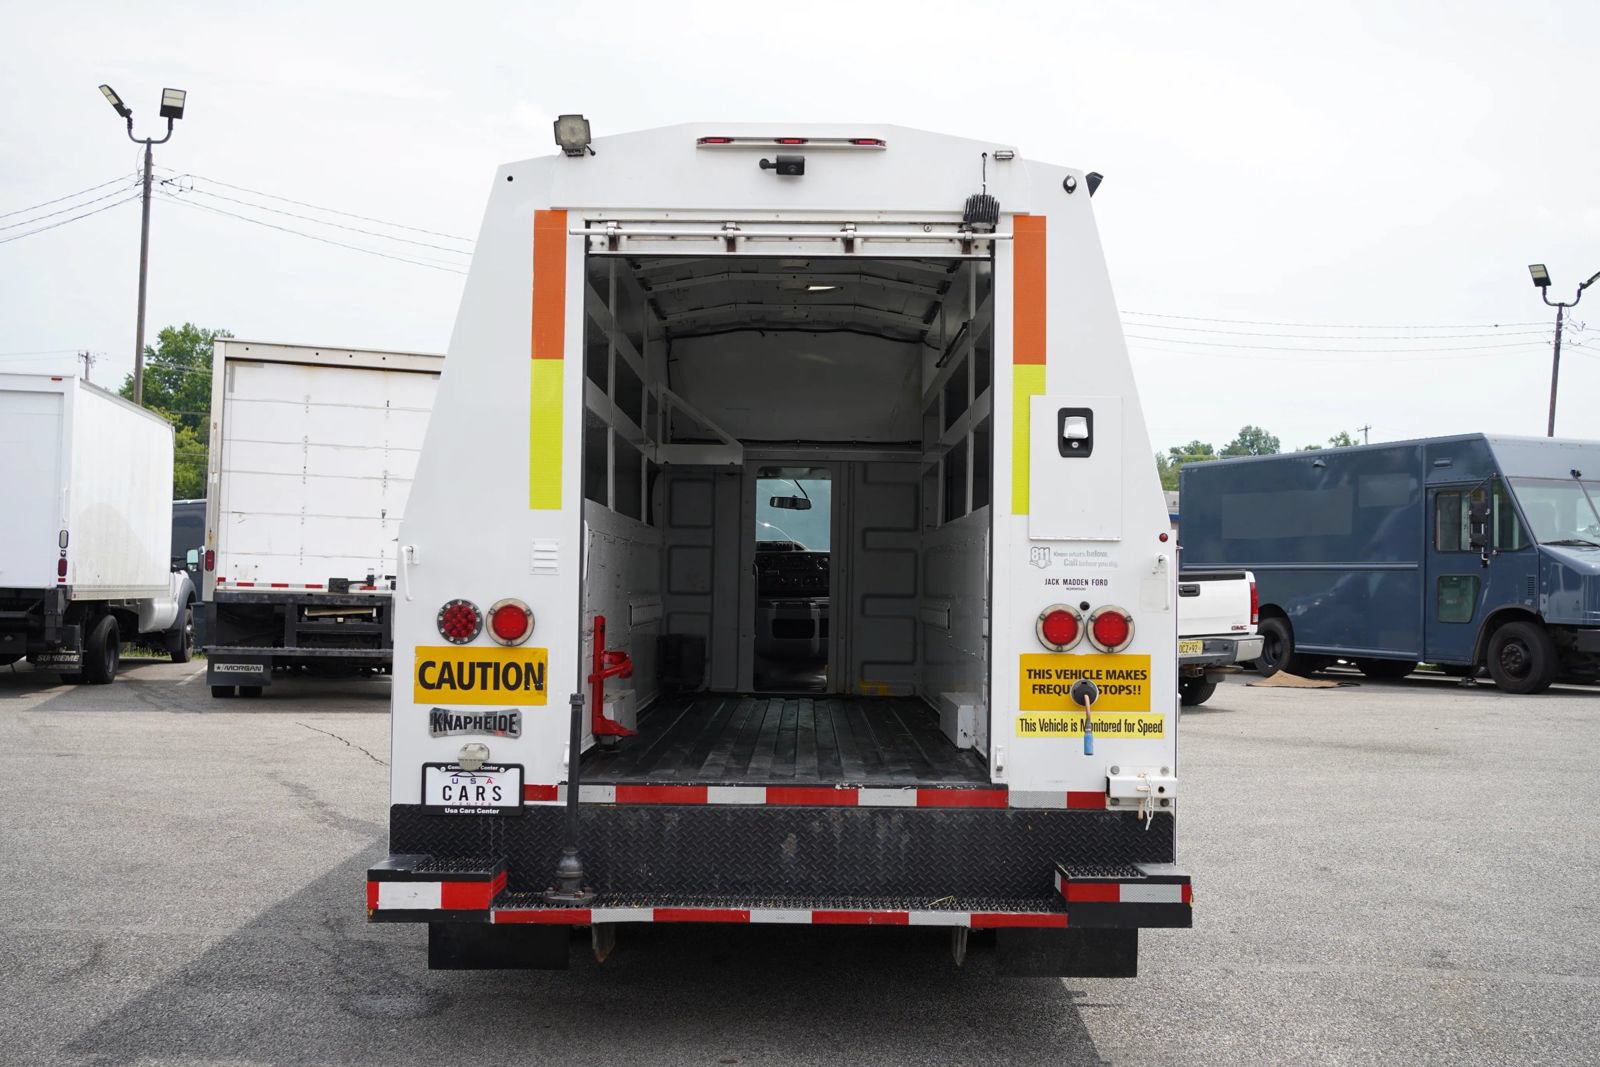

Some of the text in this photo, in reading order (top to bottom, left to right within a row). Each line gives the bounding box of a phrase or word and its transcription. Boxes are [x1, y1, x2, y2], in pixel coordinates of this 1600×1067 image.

[1031, 547, 1050, 561] 811
[1064, 558, 1078, 566] Call
[418, 660, 544, 690] CAUTION
[1026, 669, 1147, 681] THIS VEHICLE MAKES
[433, 712, 517, 734] KNAPHEIDE
[1019, 718, 1037, 732] This
[1038, 718, 1068, 732] Vehicle
[1071, 718, 1078, 732] is
[1124, 719, 1135, 733] for
[1137, 719, 1163, 736] Speed
[442, 785, 502, 801] CARS
